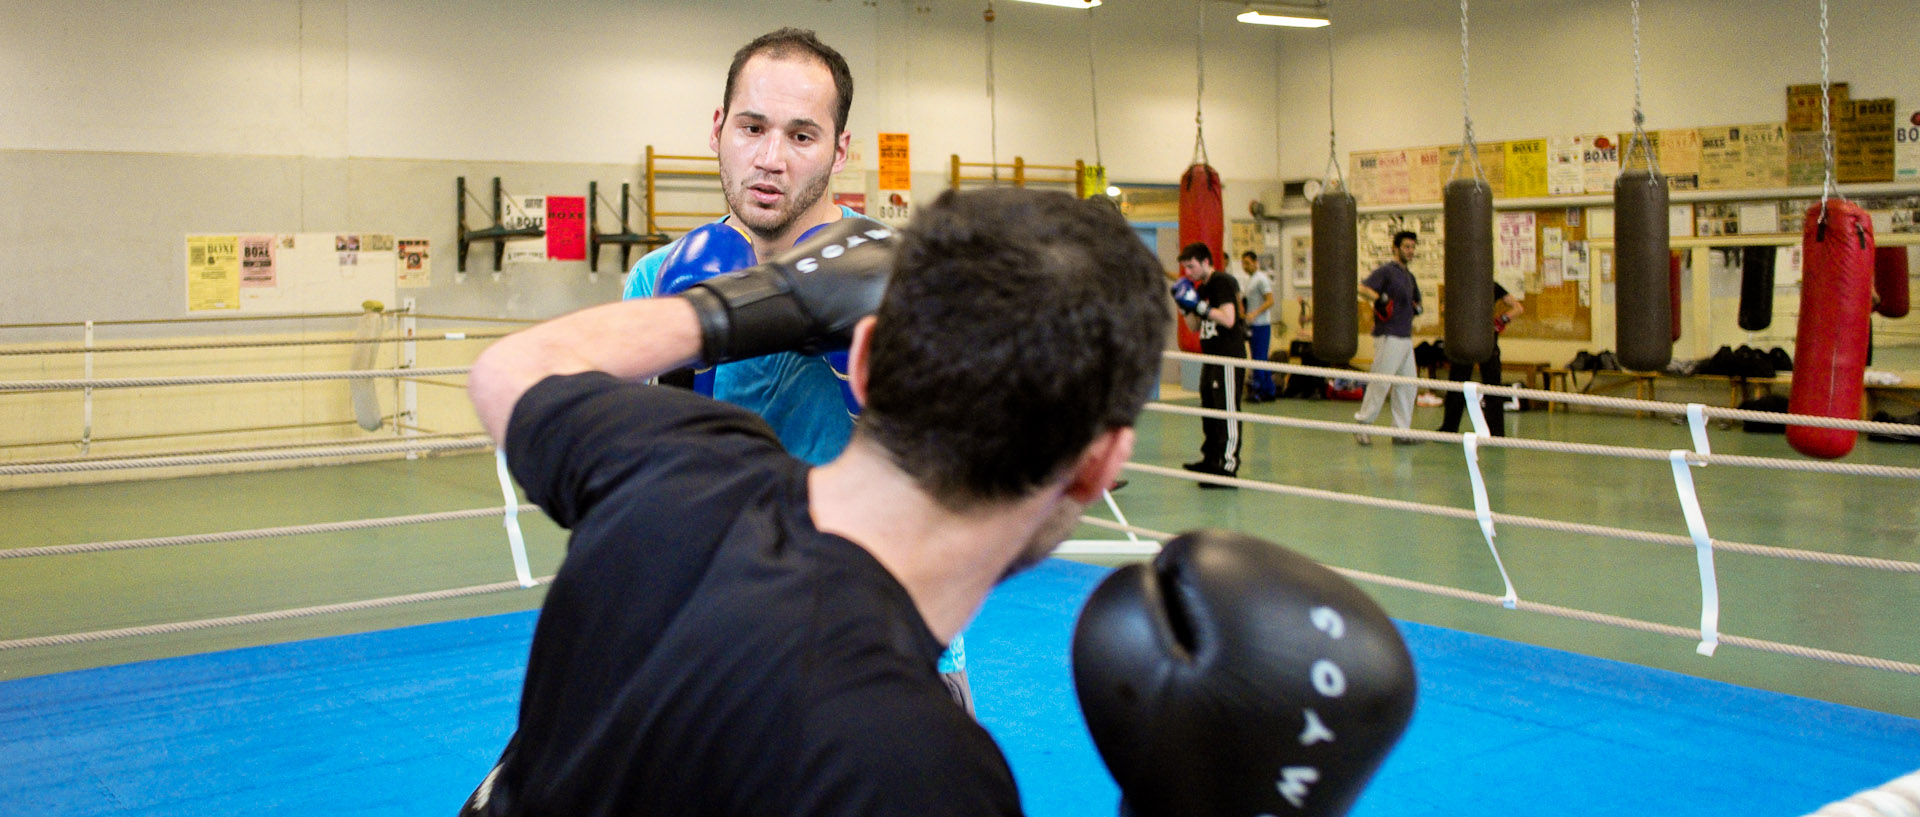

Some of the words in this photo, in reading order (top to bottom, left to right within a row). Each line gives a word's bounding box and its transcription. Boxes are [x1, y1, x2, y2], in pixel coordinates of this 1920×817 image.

[1512, 142, 1541, 153] BOXE
[1584, 149, 1617, 162] BOXE
[547, 211, 585, 219] BOXE
[879, 206, 909, 218] BOXE
[516, 217, 544, 228] BOXE
